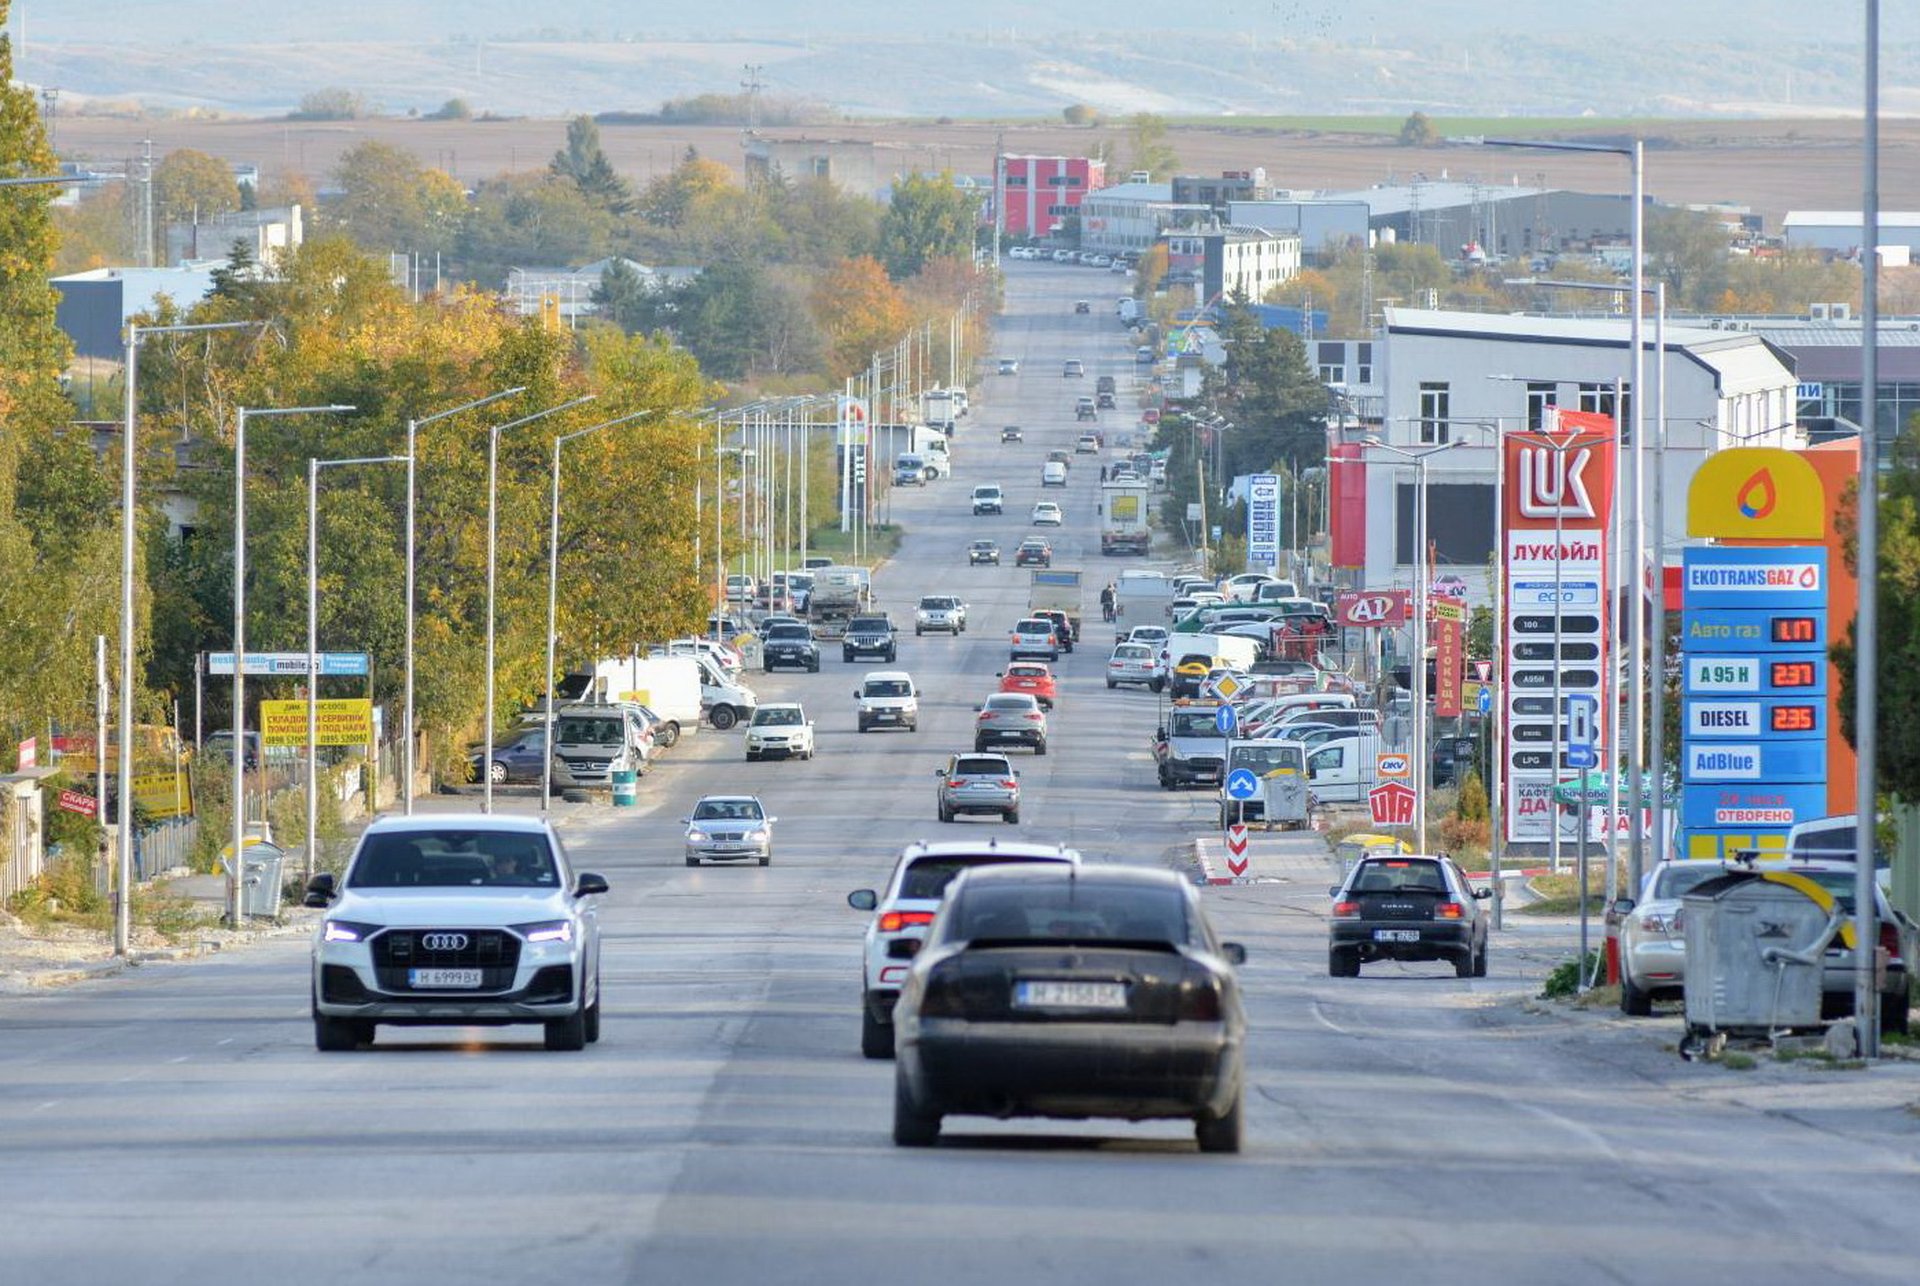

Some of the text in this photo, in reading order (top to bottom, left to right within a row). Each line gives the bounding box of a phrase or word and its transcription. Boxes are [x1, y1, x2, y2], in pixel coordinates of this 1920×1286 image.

[1691, 569, 1795, 586] EKOTRANSGAZ
[1523, 621, 1539, 629] 100
[1690, 620, 1761, 638] Авто газ
[1700, 667, 1749, 682] A 95 H
[1700, 711, 1750, 726] DIESEL
[342, 723, 367, 732] НАЕМ
[1382, 761, 1404, 769] DKV
[1522, 756, 1540, 764] LPG
[1696, 753, 1753, 770] AdBlue
[62, 792, 96, 809] СКАРА
[1717, 811, 1792, 821] ОТВОРЕНО
